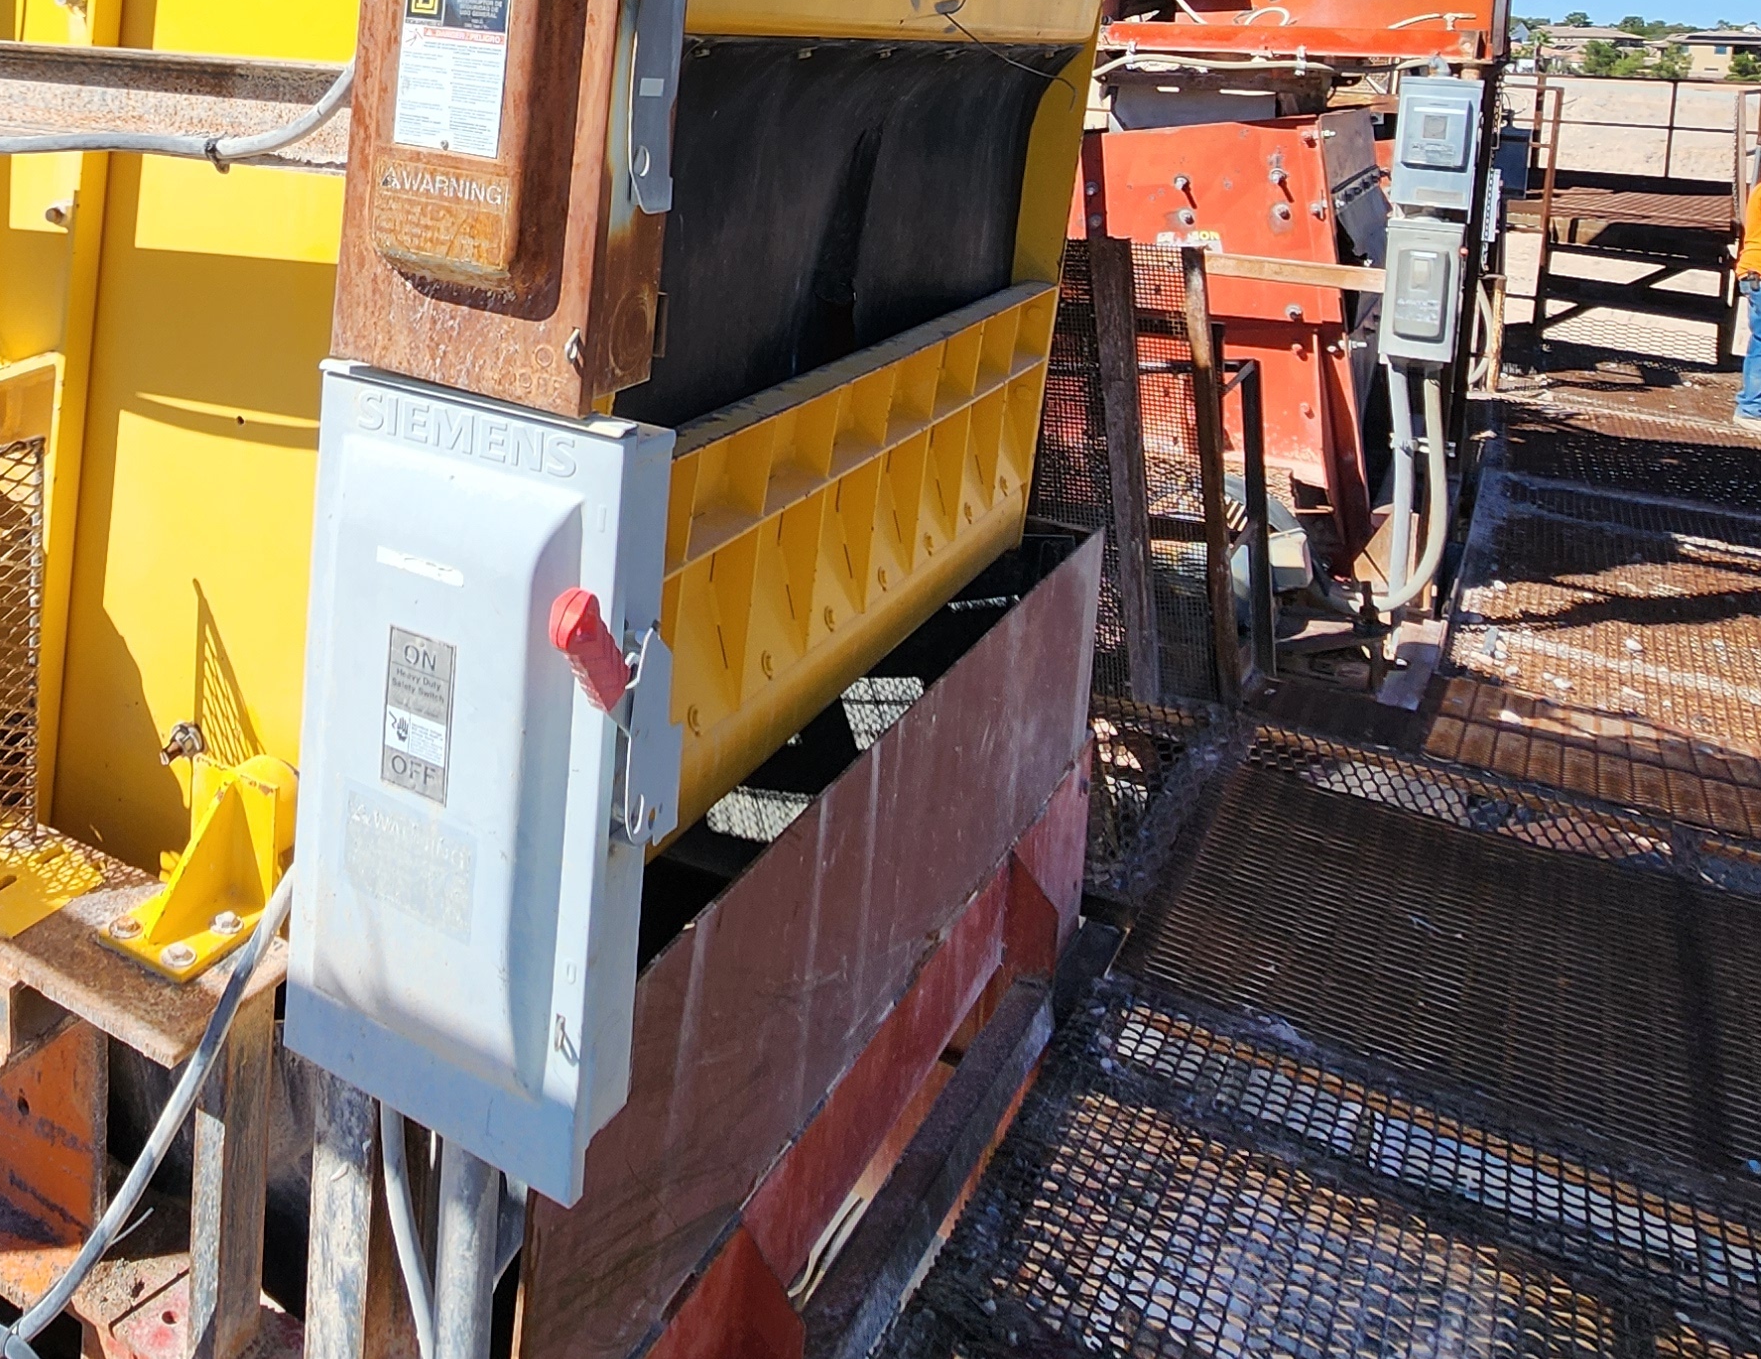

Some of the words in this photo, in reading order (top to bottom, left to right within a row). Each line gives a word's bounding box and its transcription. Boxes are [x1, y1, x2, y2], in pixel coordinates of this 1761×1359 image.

[469, 33, 501, 44] PELIGRO
[402, 170, 502, 205] WARNING
[358, 389, 577, 478] SIEMENS
[404, 644, 437, 672] ON
[392, 677, 416, 694] Safety
[418, 687, 445, 704] Switch
[396, 667, 421, 684] Heavy
[423, 677, 442, 692] Duty
[391, 754, 436, 785] OFF
